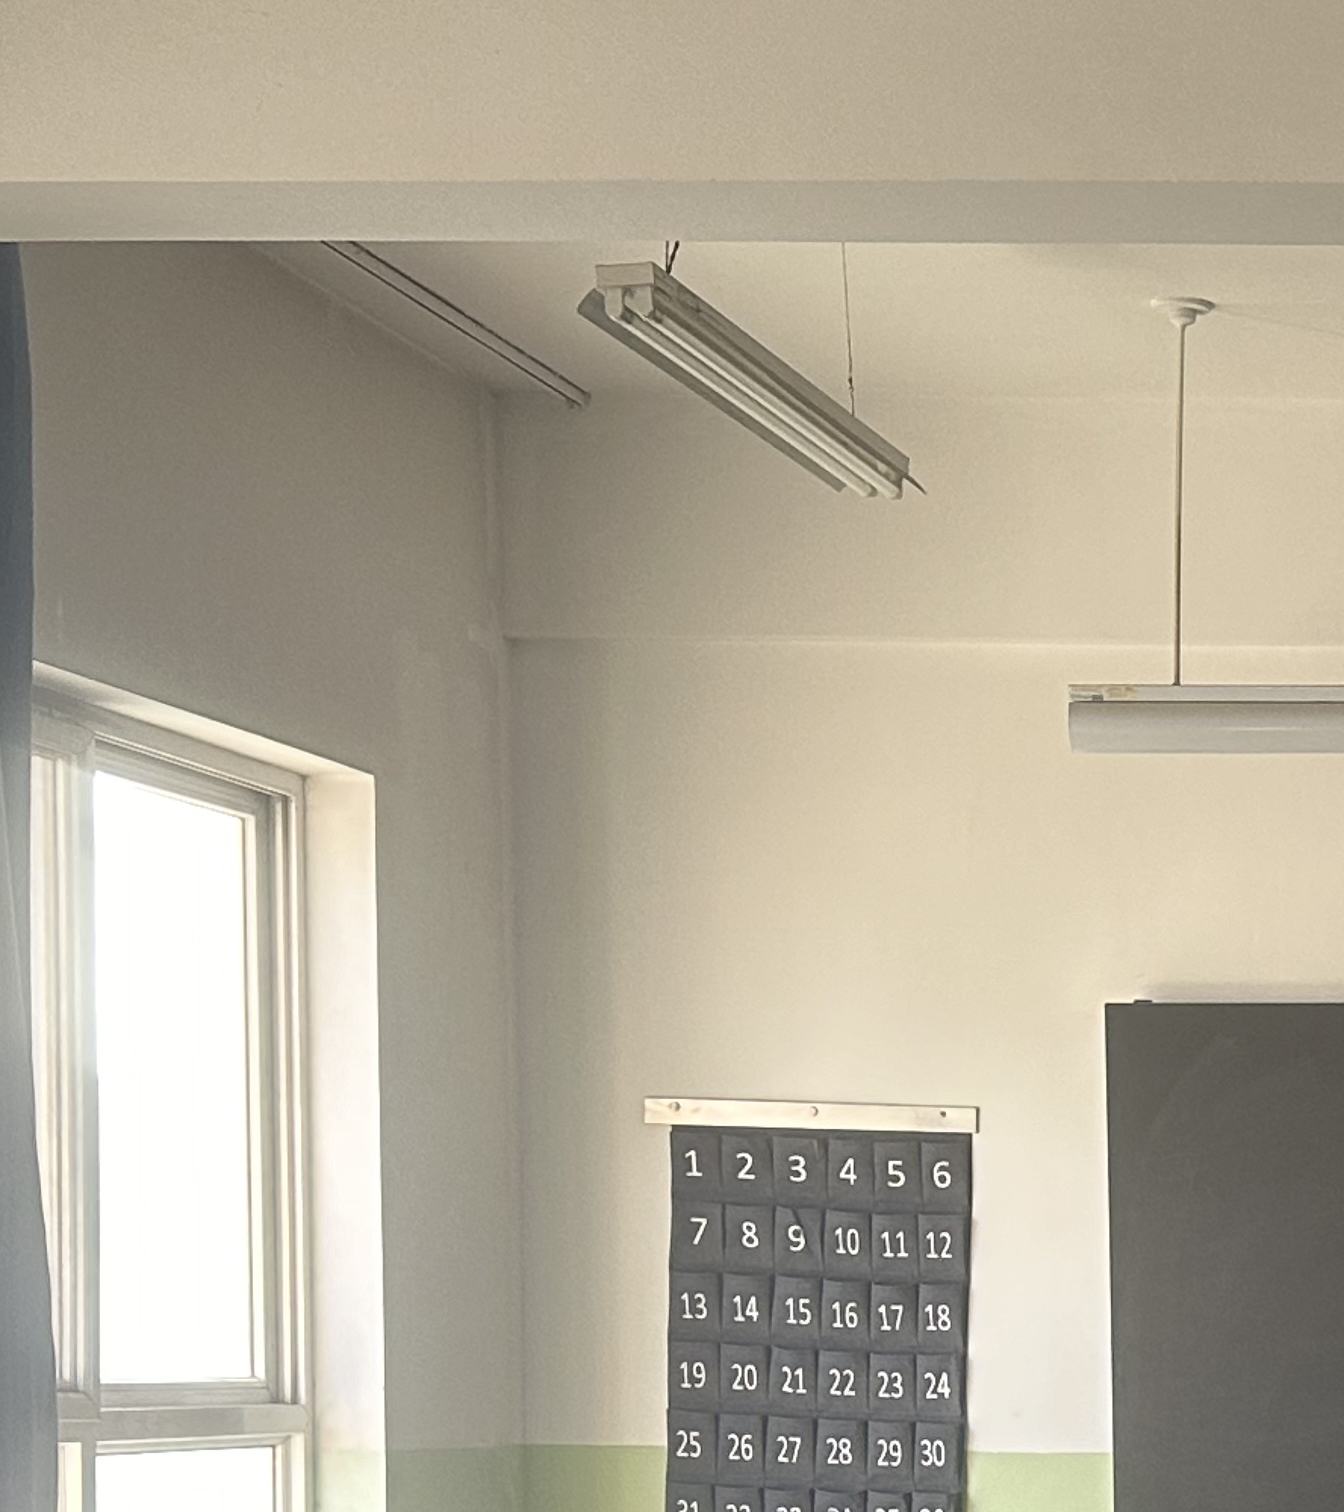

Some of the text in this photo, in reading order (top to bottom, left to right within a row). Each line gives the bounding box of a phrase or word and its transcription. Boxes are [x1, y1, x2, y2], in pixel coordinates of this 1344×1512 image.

[685, 1149, 952, 1189] 1 2 3 4 5 6
[690, 1217, 953, 1259] 7 8 9 10 11 12
[680, 1292, 952, 1331] 13 14 15 16 17 18
[679, 1361, 951, 1400] 19 20 21 22 23 24
[676, 1429, 946, 1467] 25 26 27 28 29 30
